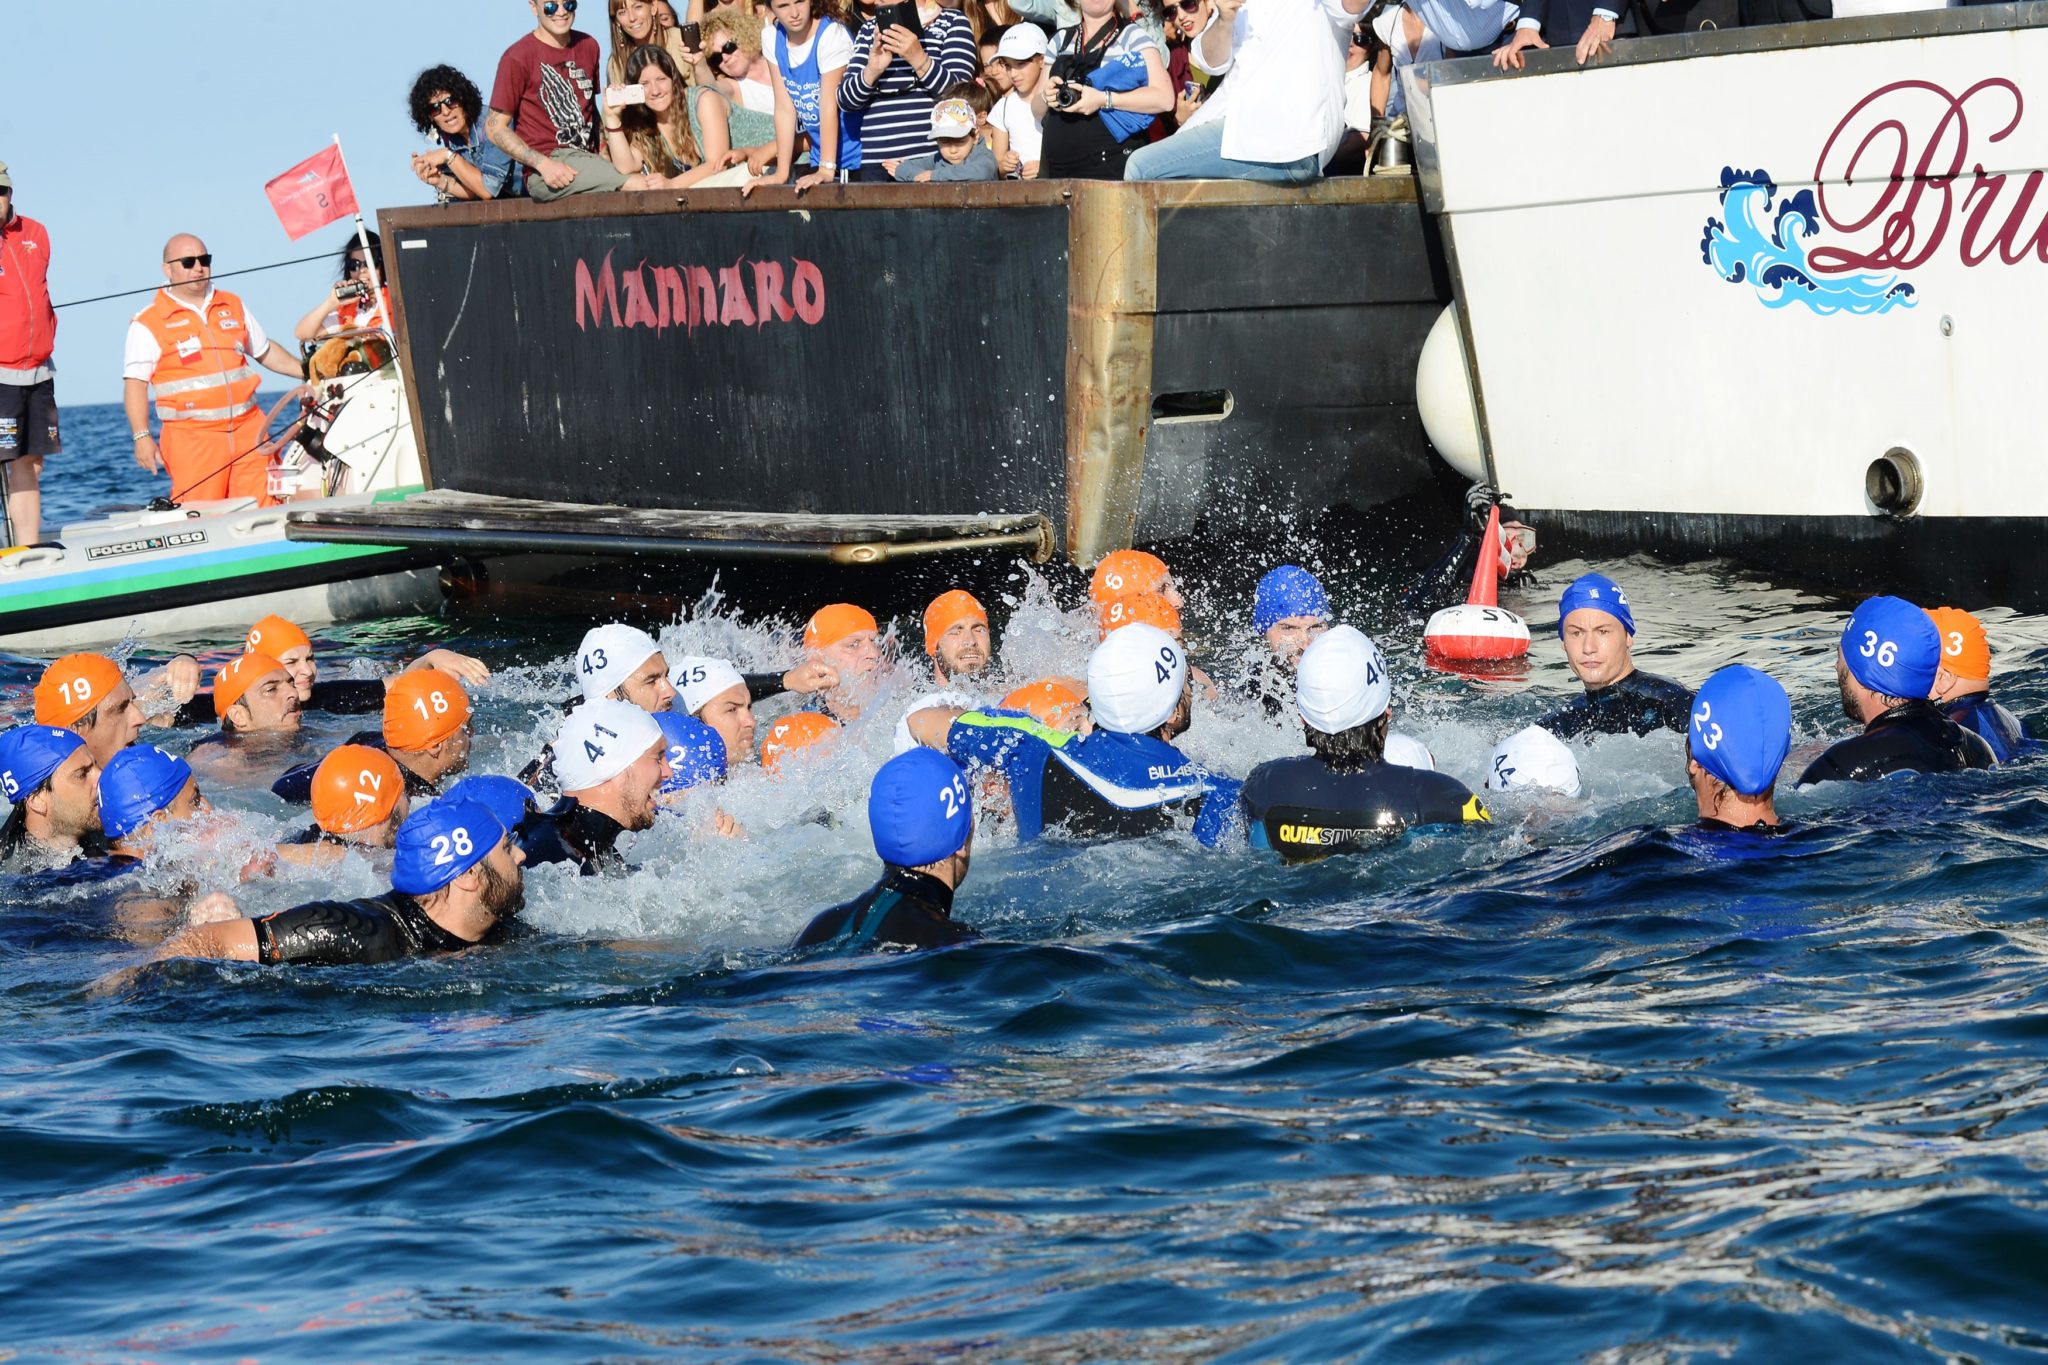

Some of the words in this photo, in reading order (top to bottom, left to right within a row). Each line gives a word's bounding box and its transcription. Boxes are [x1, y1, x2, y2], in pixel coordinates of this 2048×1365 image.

[90, 540, 149, 558] FOCCHI
[168, 531, 204, 545] 650
[1860, 631, 1898, 667] 36
[1945, 631, 1964, 657] 3
[219, 658, 243, 682] 17
[582, 648, 608, 675] 43
[676, 665, 707, 688] 45
[1155, 646, 1177, 684] 49
[1366, 651, 1386, 686] 46
[58, 677, 92, 705] 19
[414, 691, 448, 720] 18
[1694, 701, 1723, 751] 23
[583, 723, 618, 763] 41
[1148, 761, 1208, 781] BILLAB
[353, 769, 382, 806] 12
[940, 773, 966, 819] 25
[430, 827, 473, 866] 28
